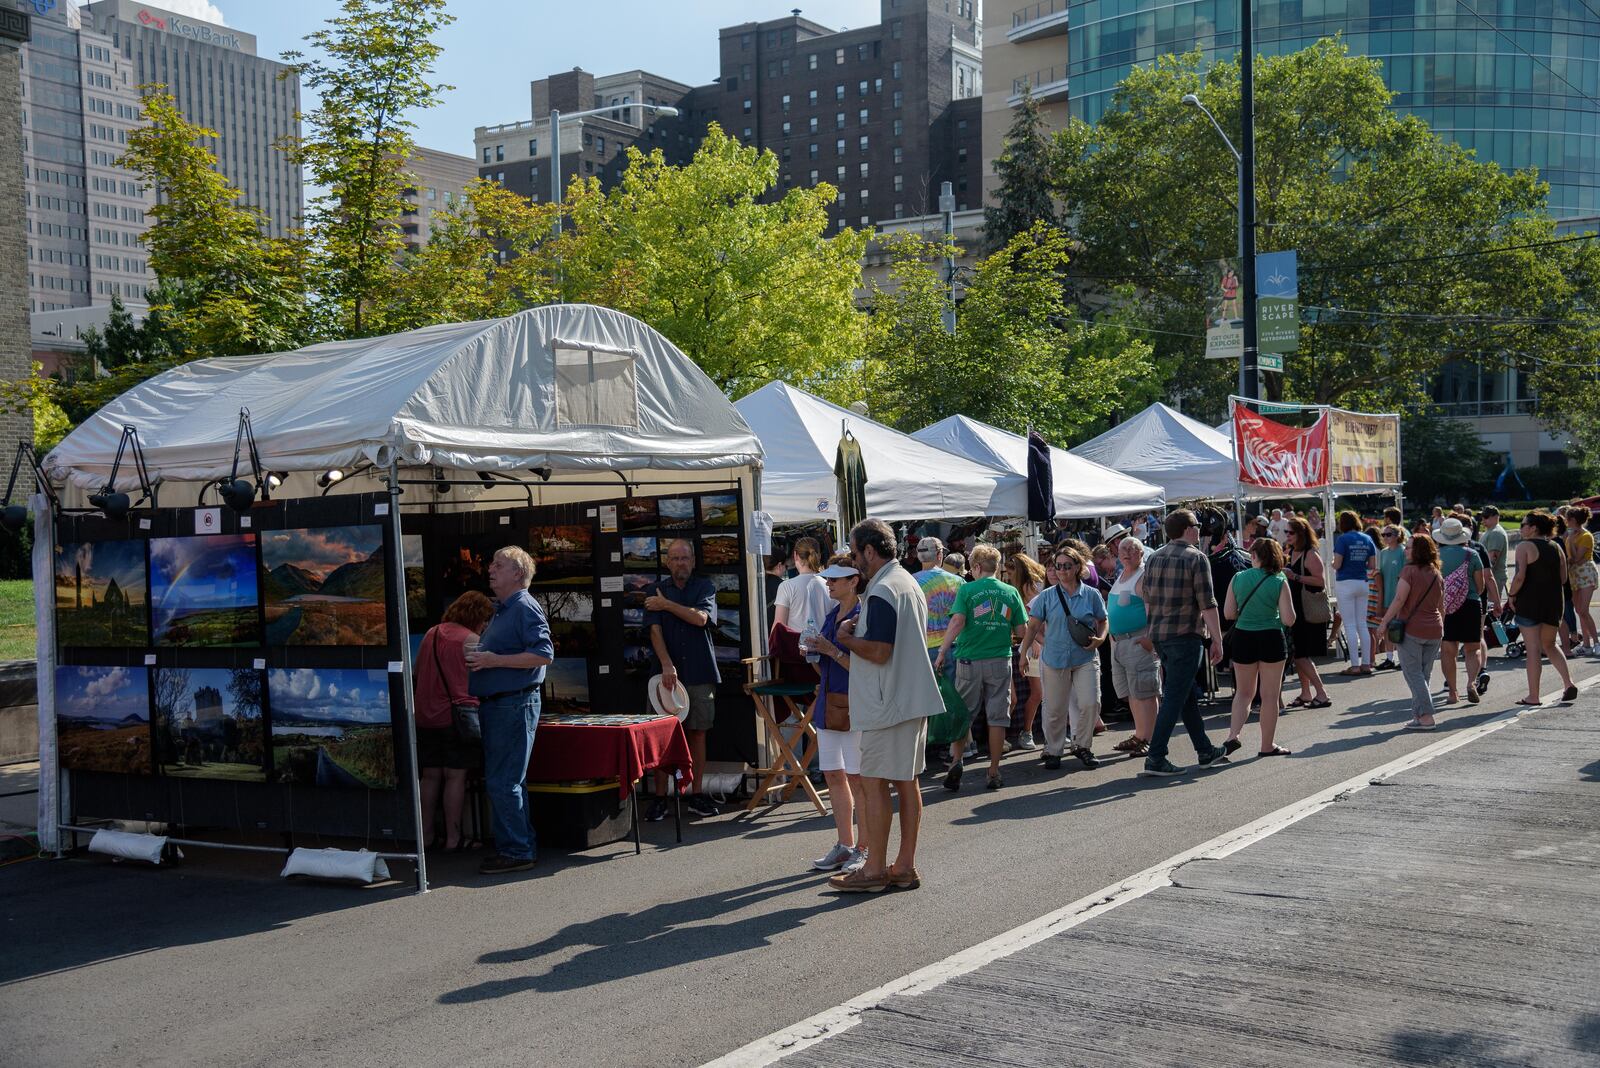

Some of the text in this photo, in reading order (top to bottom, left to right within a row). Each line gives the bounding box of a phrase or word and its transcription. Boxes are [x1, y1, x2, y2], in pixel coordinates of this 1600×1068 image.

[170, 17, 240, 49] KeyBank
[1262, 304, 1294, 313] RIVER
[1262, 312, 1294, 321] SCAPE
[1210, 339, 1241, 347] EXPLORE
